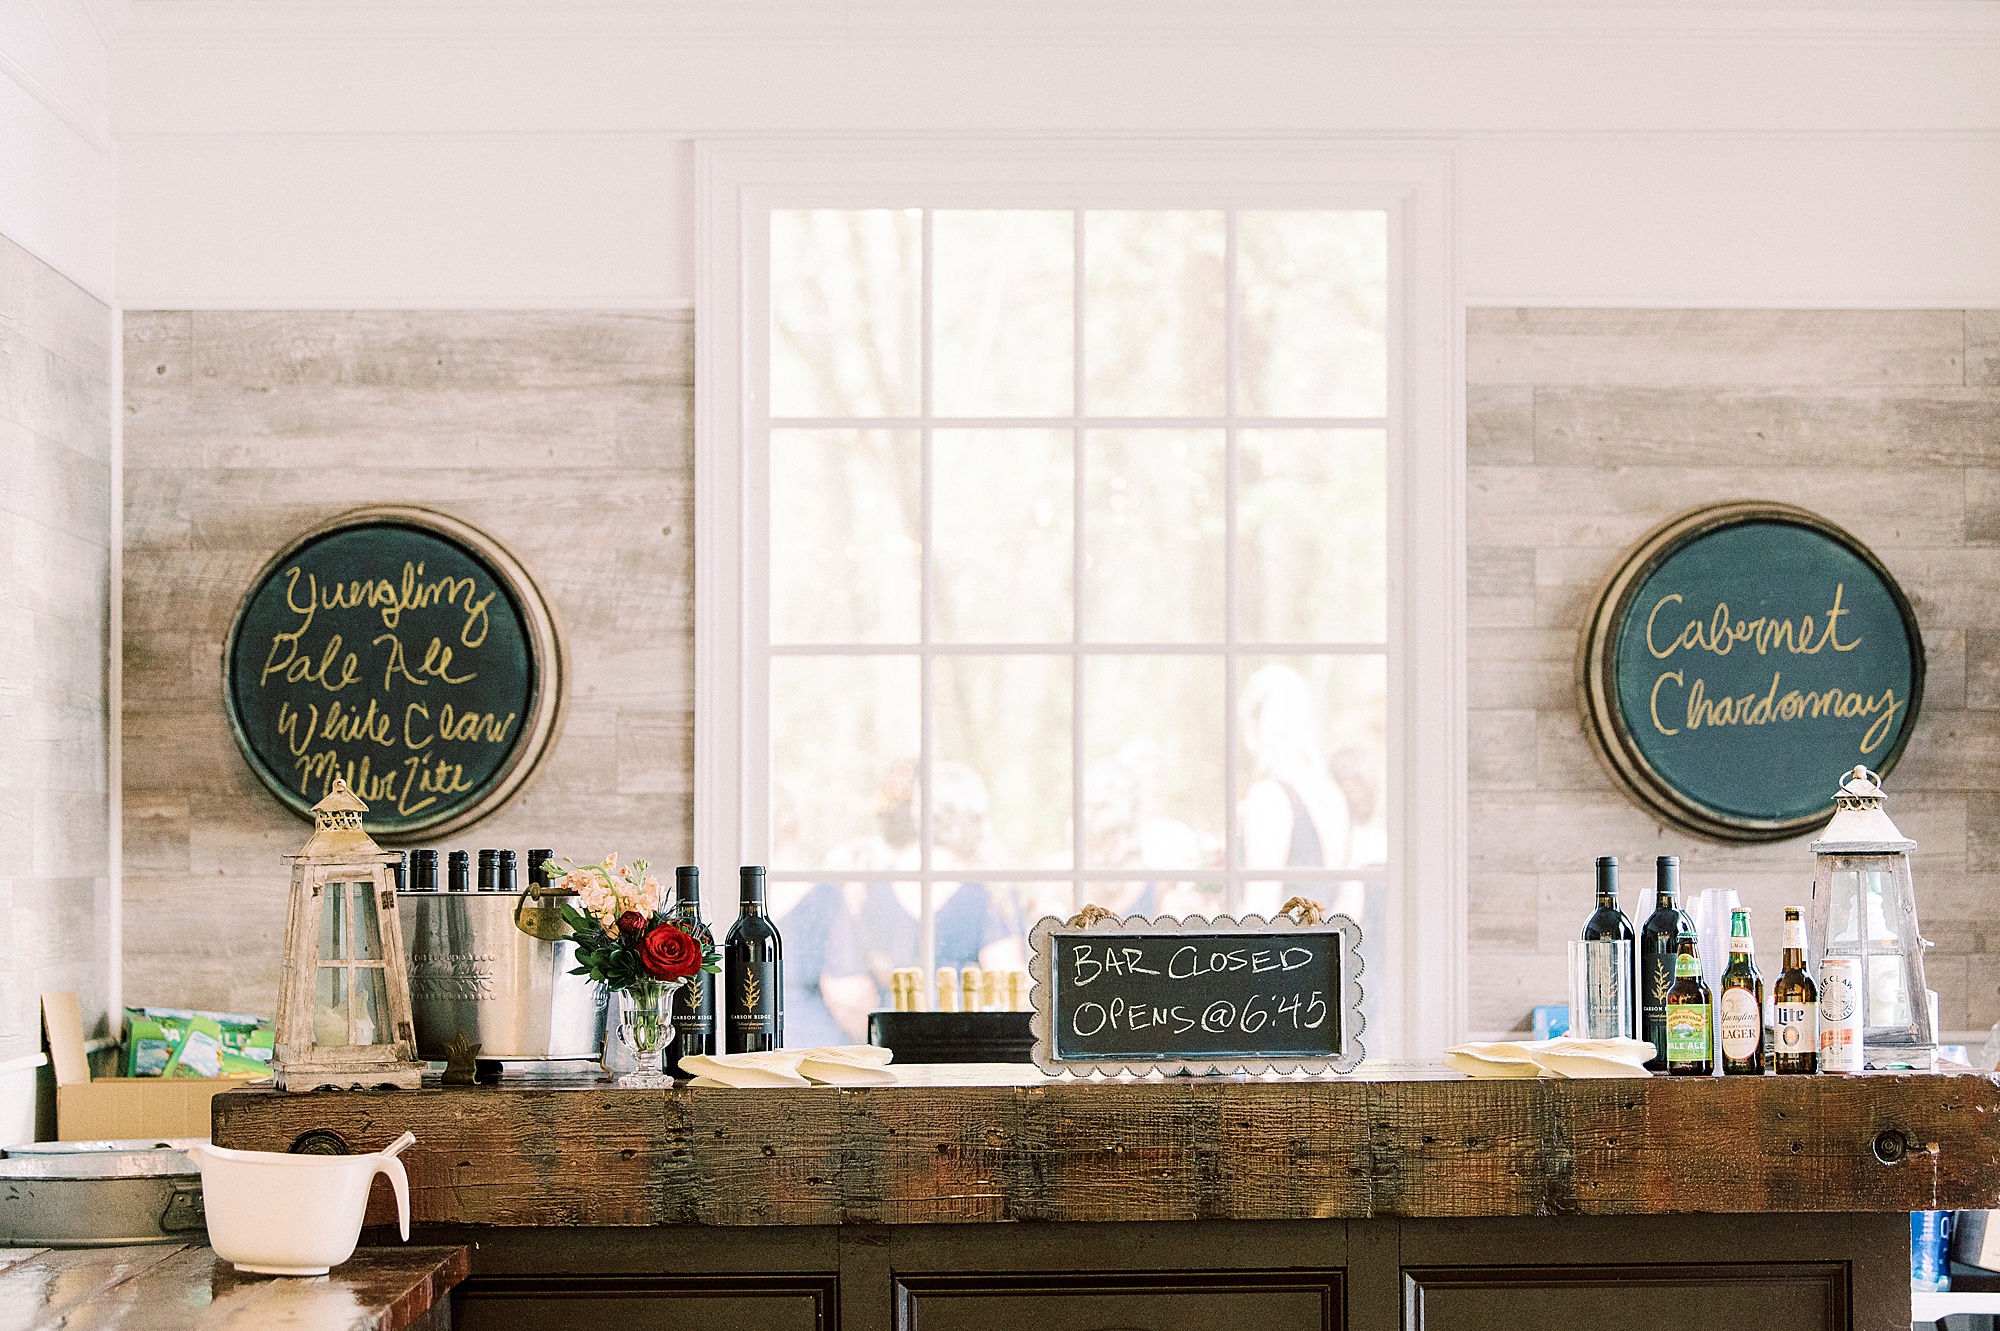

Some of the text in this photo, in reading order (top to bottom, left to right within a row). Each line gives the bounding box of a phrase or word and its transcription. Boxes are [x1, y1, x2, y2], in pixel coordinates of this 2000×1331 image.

[285, 561, 496, 648] Yuengling
[1647, 583, 1862, 659] Cabernet
[260, 631, 478, 692] Pale Ale
[278, 699, 515, 756] White Claw
[1650, 669, 1903, 754] Chardonnay
[397, 752, 474, 816] Lite
[1072, 944, 1314, 987] BAR CLOSED
[1829, 975, 1853, 990] CLAW
[1721, 1010, 1758, 1024] Yuengling
[1722, 1029, 1757, 1040] LAGER
[1777, 1007, 1804, 1026] Lite
[1687, 1042, 1705, 1050] ALE
